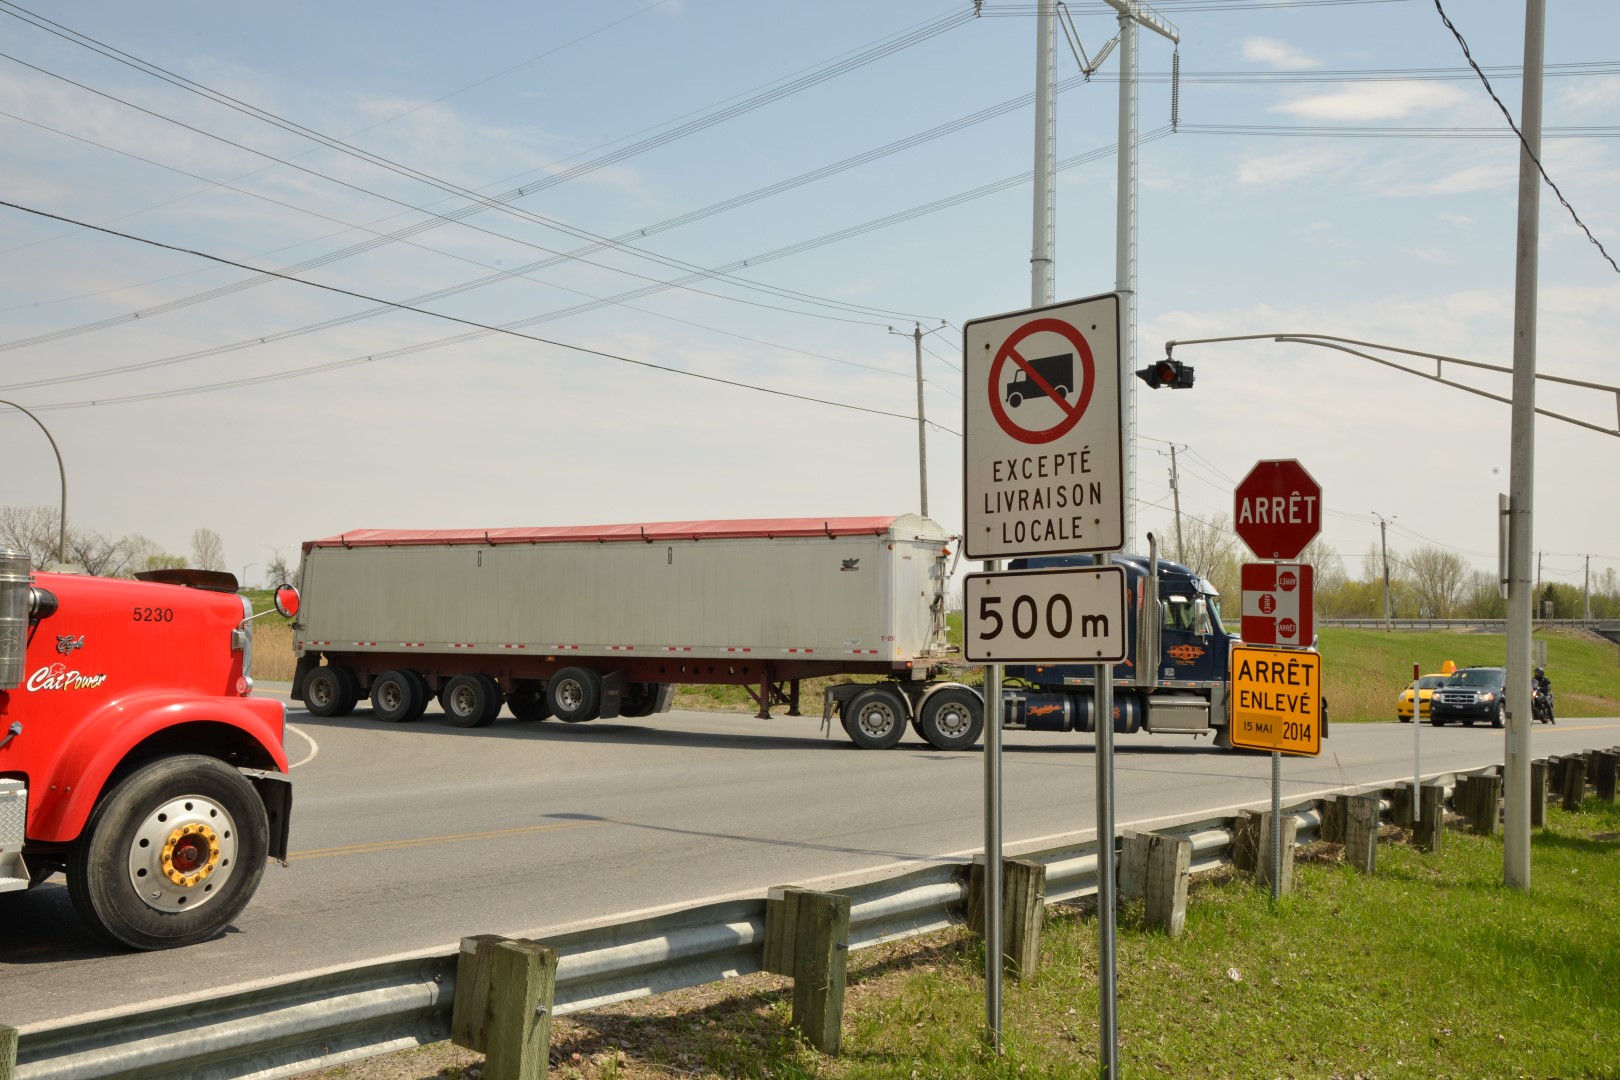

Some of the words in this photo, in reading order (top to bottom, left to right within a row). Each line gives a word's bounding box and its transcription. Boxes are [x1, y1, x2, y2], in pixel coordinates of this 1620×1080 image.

[993, 445, 1091, 482] EXCEPTÉ
[984, 482, 1101, 514] LIVRAISON
[1239, 491, 1317, 524] ARRÊT
[1002, 516, 1083, 544] LOCALE
[132, 607, 174, 622] 5230
[979, 593, 1073, 640] 500
[1081, 612, 1109, 637] m
[1238, 658, 1314, 687] ARRÊT
[1240, 690, 1311, 714] ENLEVÉ
[1243, 721, 1253, 732] 15
[1255, 723, 1273, 734] MAI
[1283, 721, 1312, 742] 2014
